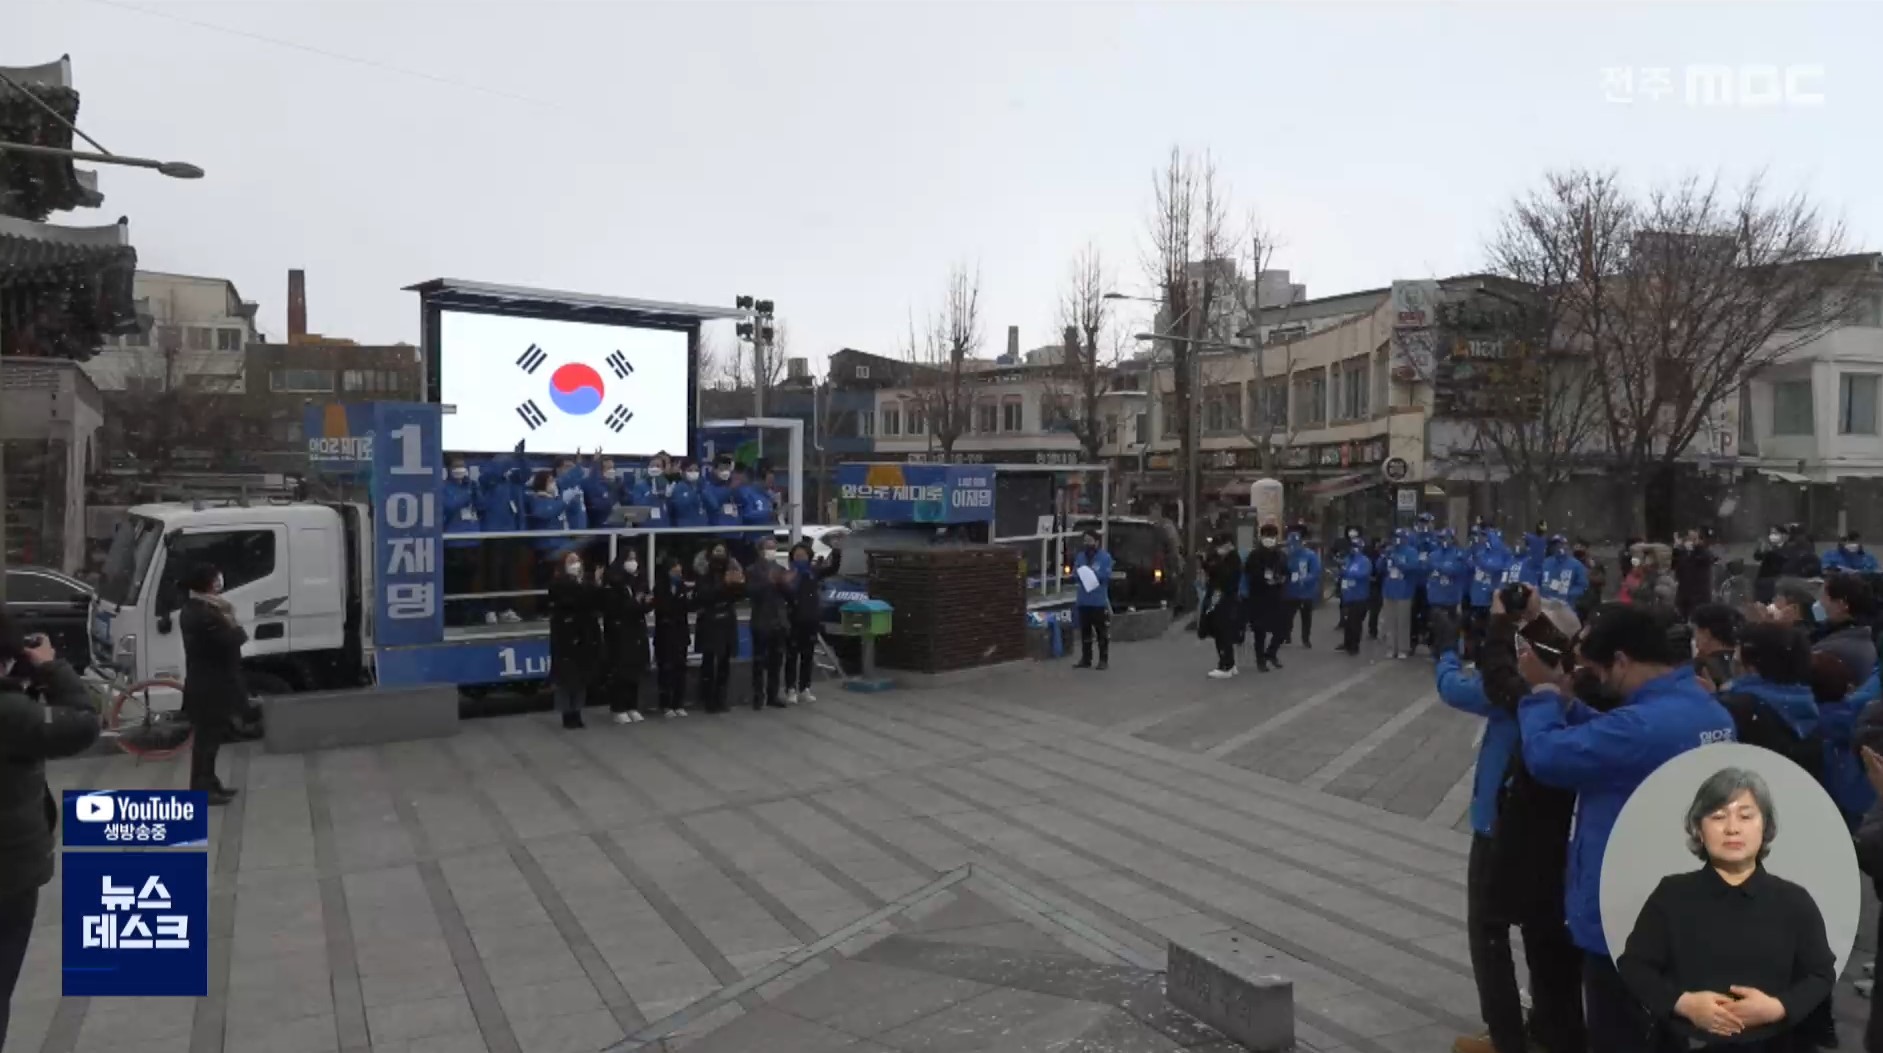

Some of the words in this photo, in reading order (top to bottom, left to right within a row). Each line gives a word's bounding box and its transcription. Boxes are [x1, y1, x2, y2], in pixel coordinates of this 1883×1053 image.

[390, 423, 433, 475] 1
[841, 484, 889, 500] 앞으로
[891, 484, 944, 501] 제대로
[951, 489, 992, 508] 이재명
[386, 492, 435, 618] 이재명
